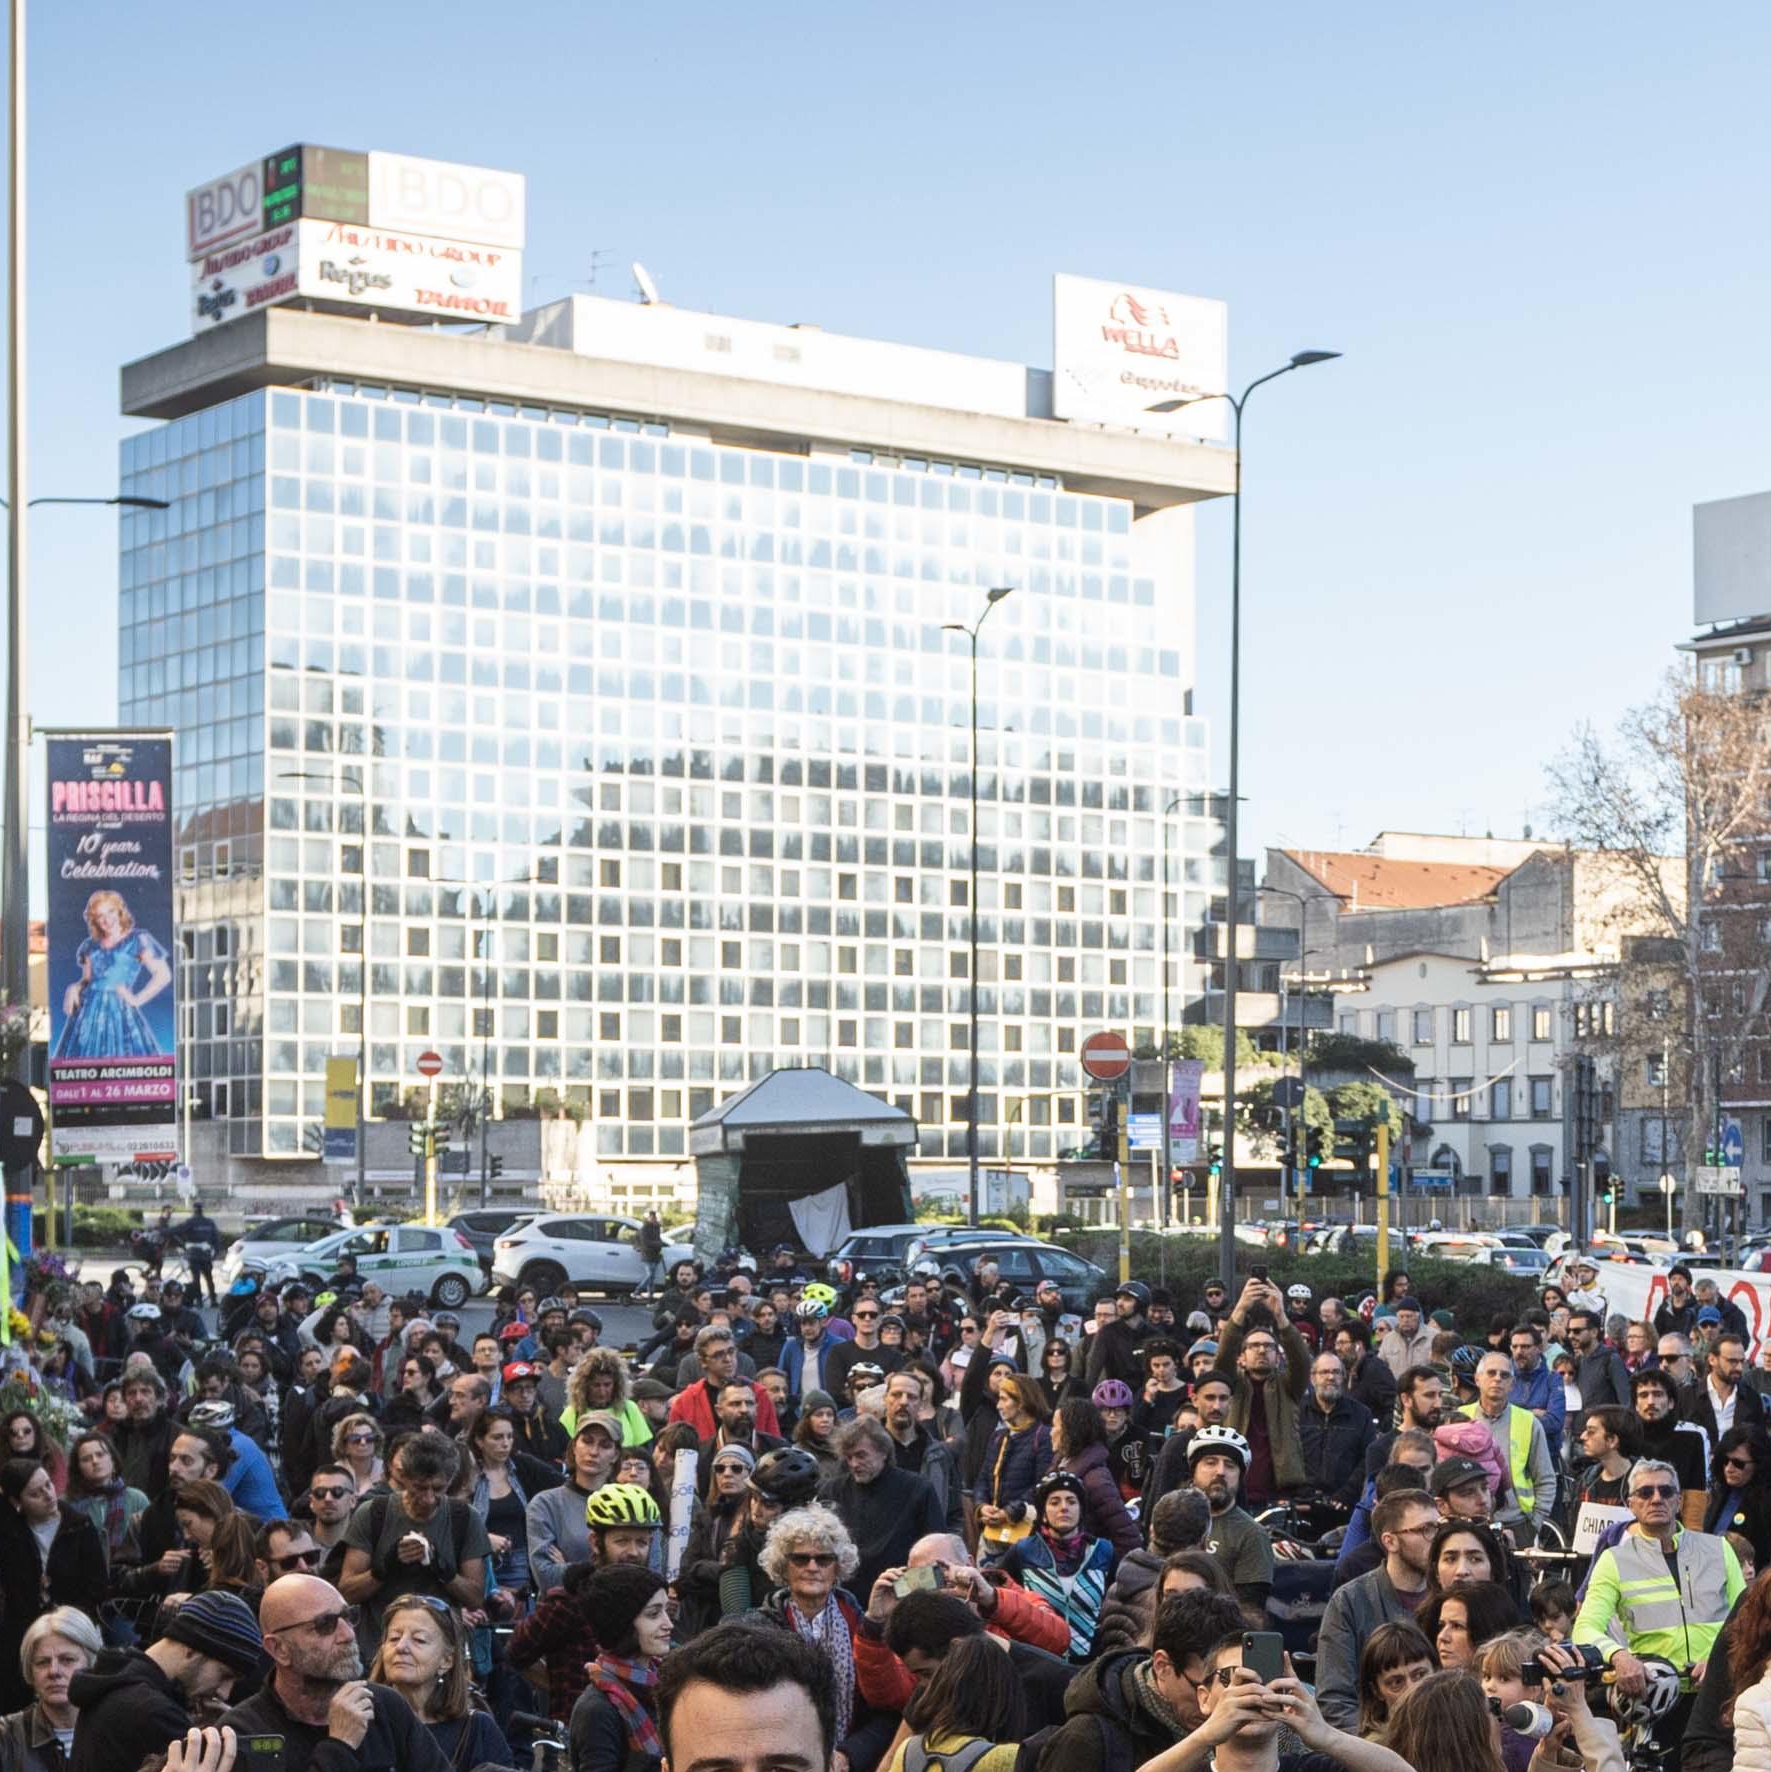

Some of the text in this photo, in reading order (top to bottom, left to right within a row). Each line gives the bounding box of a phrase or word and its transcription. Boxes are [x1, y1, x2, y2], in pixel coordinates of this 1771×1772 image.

[197, 172, 259, 235] BDO
[319, 260, 393, 294] Regus
[414, 287, 515, 318] TAMOIL
[1101, 325, 1180, 354] WELLA
[52, 780, 165, 813] PRISCILLA
[53, 812, 165, 823] LA REGINA DEL DESERTO
[76, 832, 142, 861] 10 years
[60, 858, 160, 880] Celebration
[54, 1065, 172, 1080] TEATRO ARCIMBOLDI
[105, 1085, 121, 1098] 26
[123, 1083, 170, 1097] MARZO
